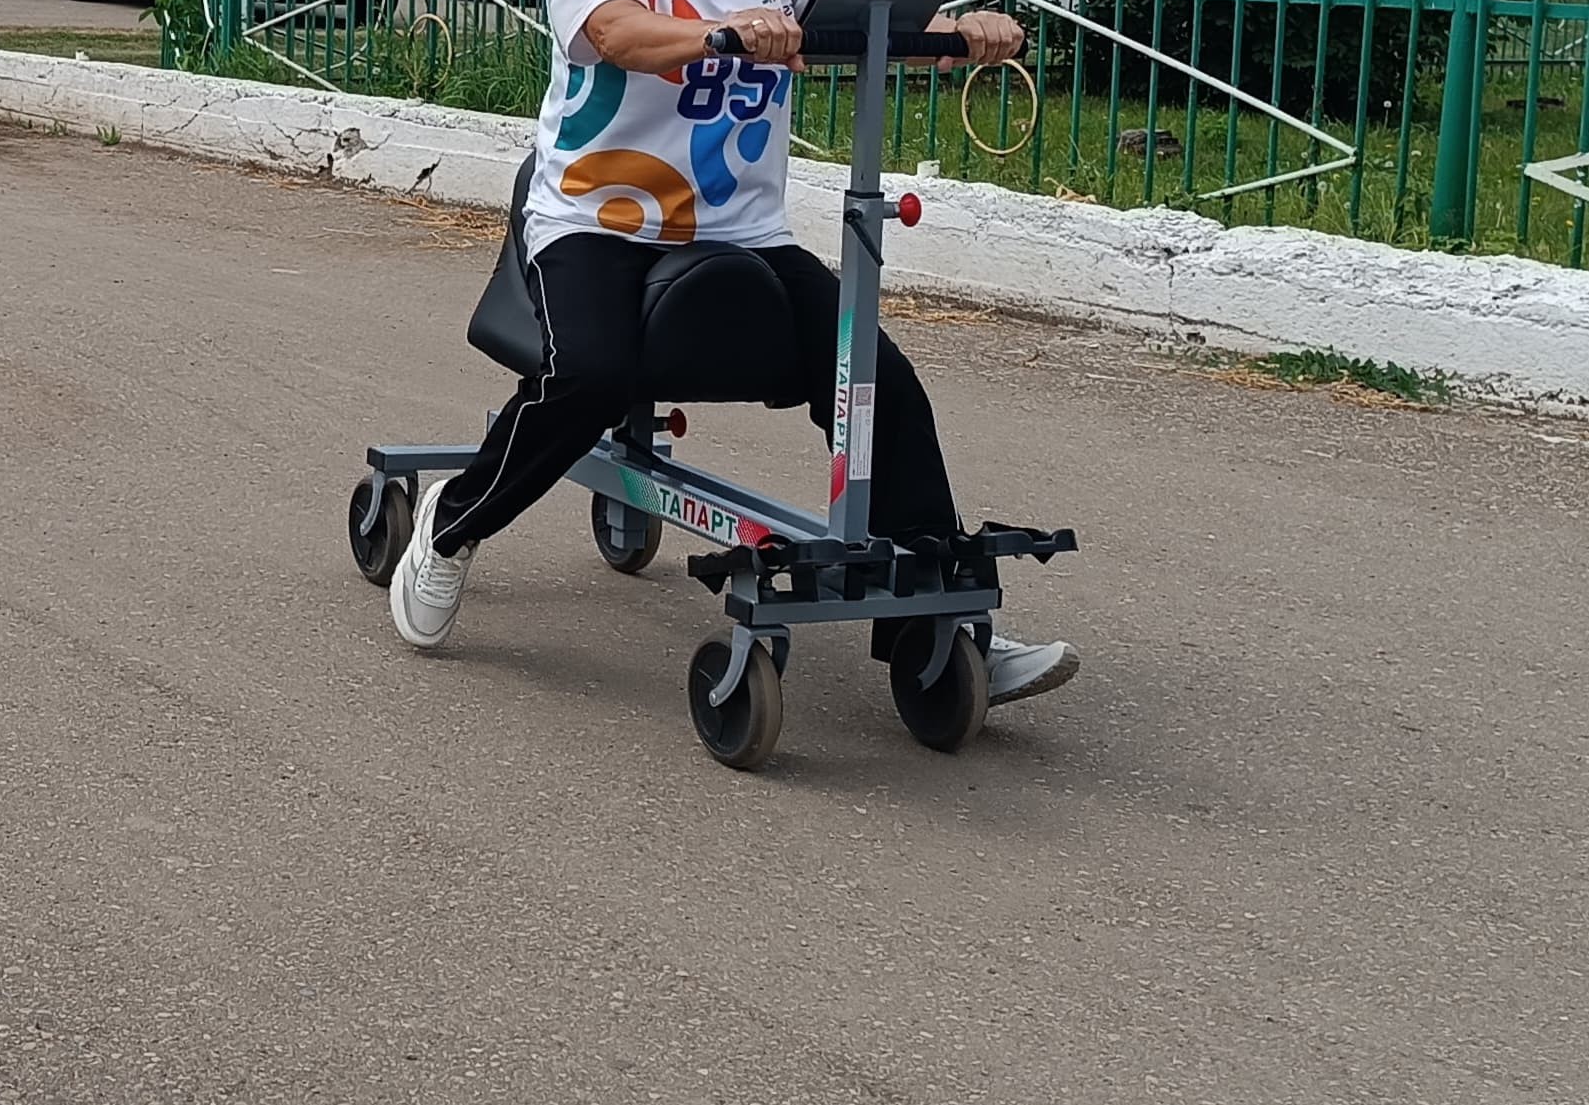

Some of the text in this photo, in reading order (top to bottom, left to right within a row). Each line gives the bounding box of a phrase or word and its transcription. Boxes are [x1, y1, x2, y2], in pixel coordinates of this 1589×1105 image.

[676, 56, 779, 122] 85
[835, 359, 849, 451] ТАПАРТ
[659, 488, 737, 540] ТАПАРТ
